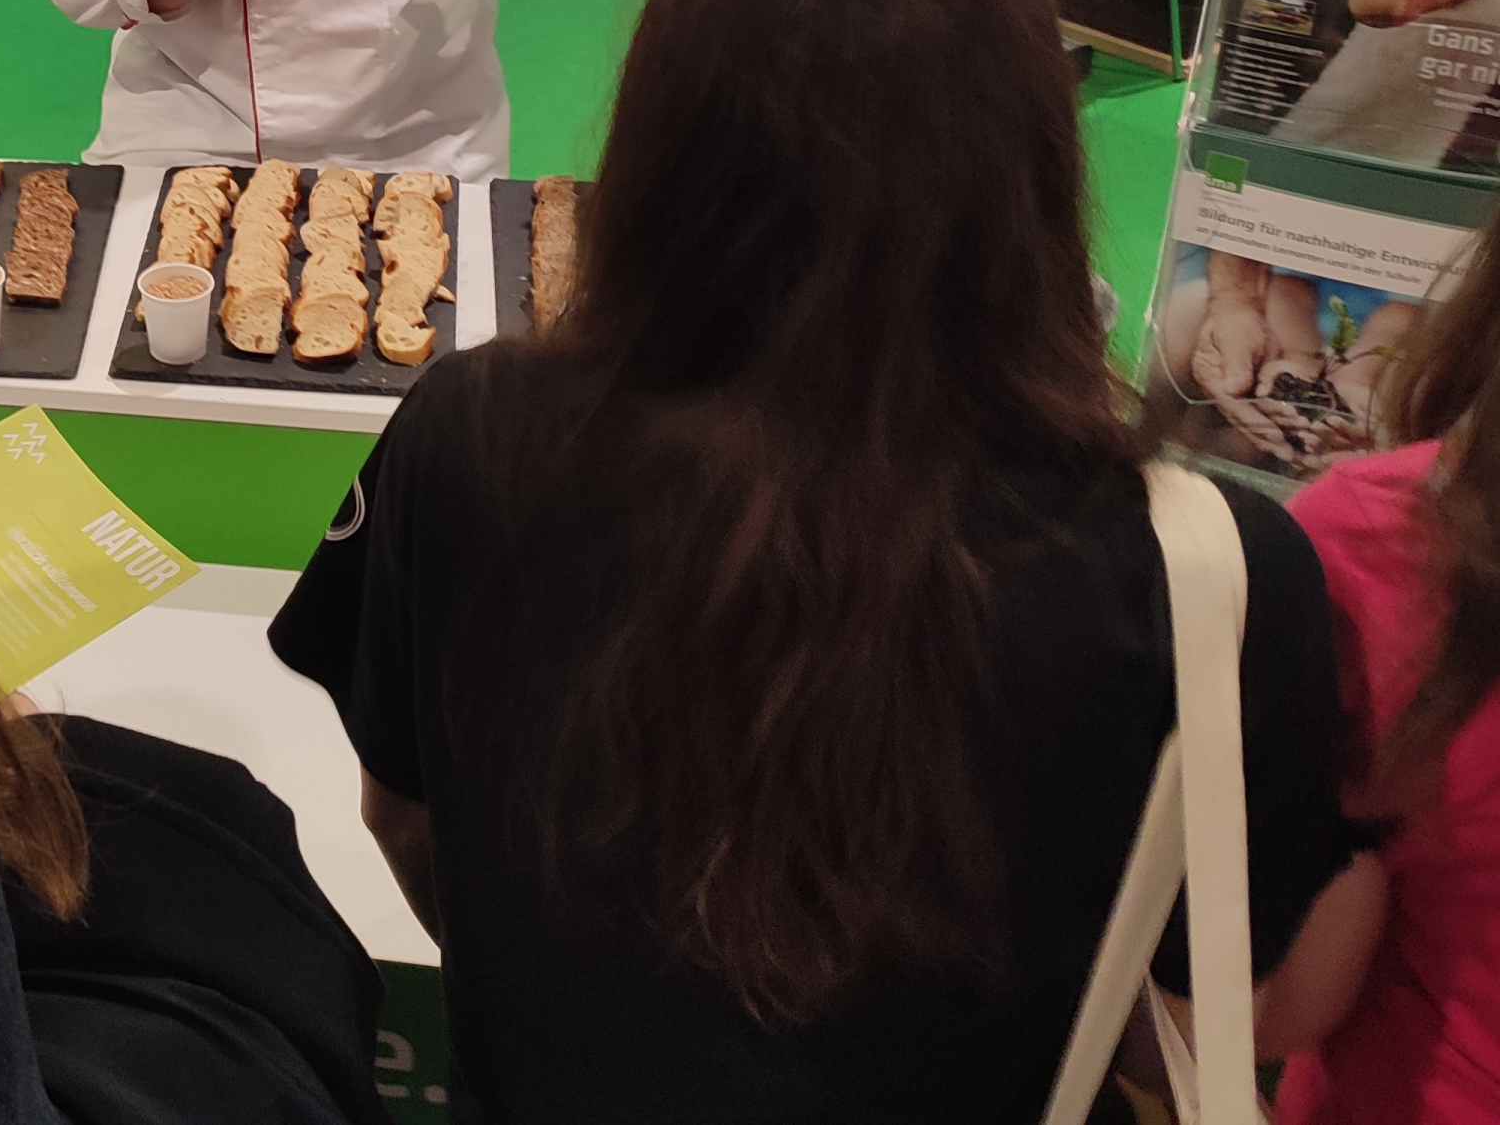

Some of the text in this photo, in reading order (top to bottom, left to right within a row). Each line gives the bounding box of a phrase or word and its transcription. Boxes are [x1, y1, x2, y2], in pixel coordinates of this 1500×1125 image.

[1427, 26, 1494, 55] Gans
[1417, 56, 1467, 80] gar
[1198, 206, 1255, 233] Bildung
[1285, 229, 1377, 259] nachhaltige
[81, 510, 181, 591] NATUR
